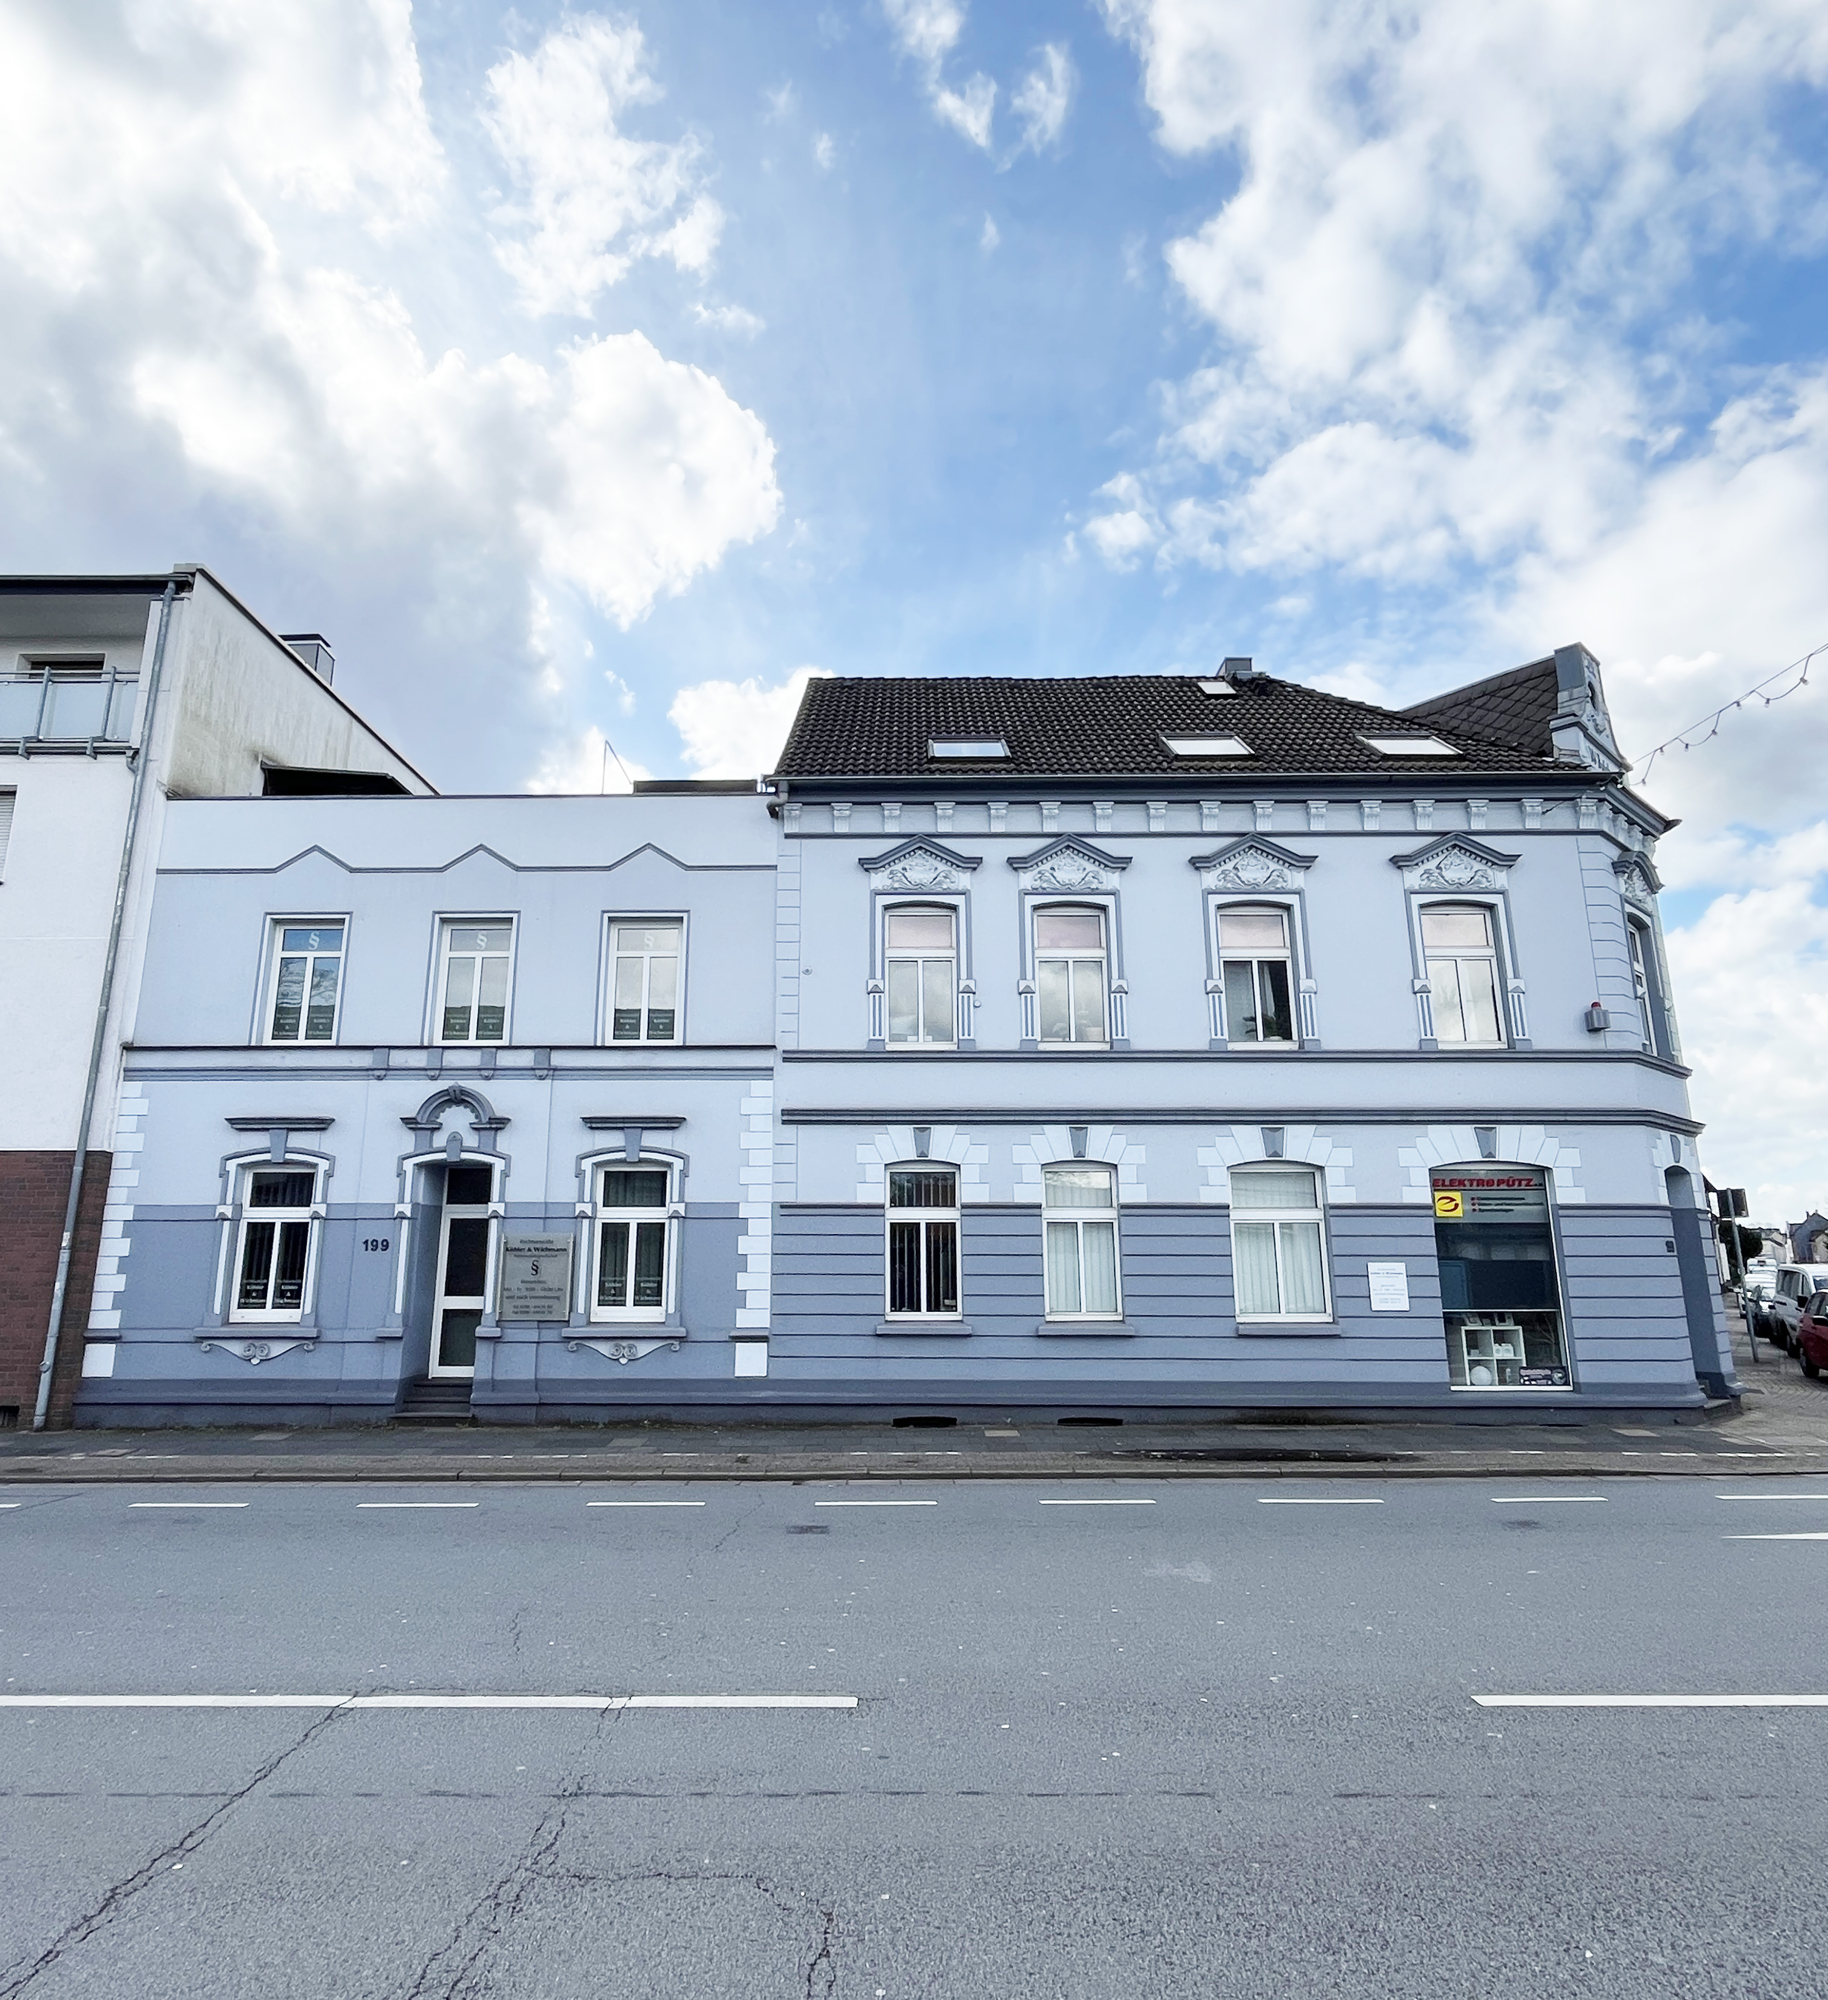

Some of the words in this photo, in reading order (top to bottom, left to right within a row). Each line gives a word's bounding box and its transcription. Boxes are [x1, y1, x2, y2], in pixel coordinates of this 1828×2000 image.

[1432, 1178, 1495, 1188] ELEKTRO
[1496, 1176, 1534, 1188] PÜTZ
[362, 1238, 390, 1252] 199
[530, 1259, 539, 1276] §
